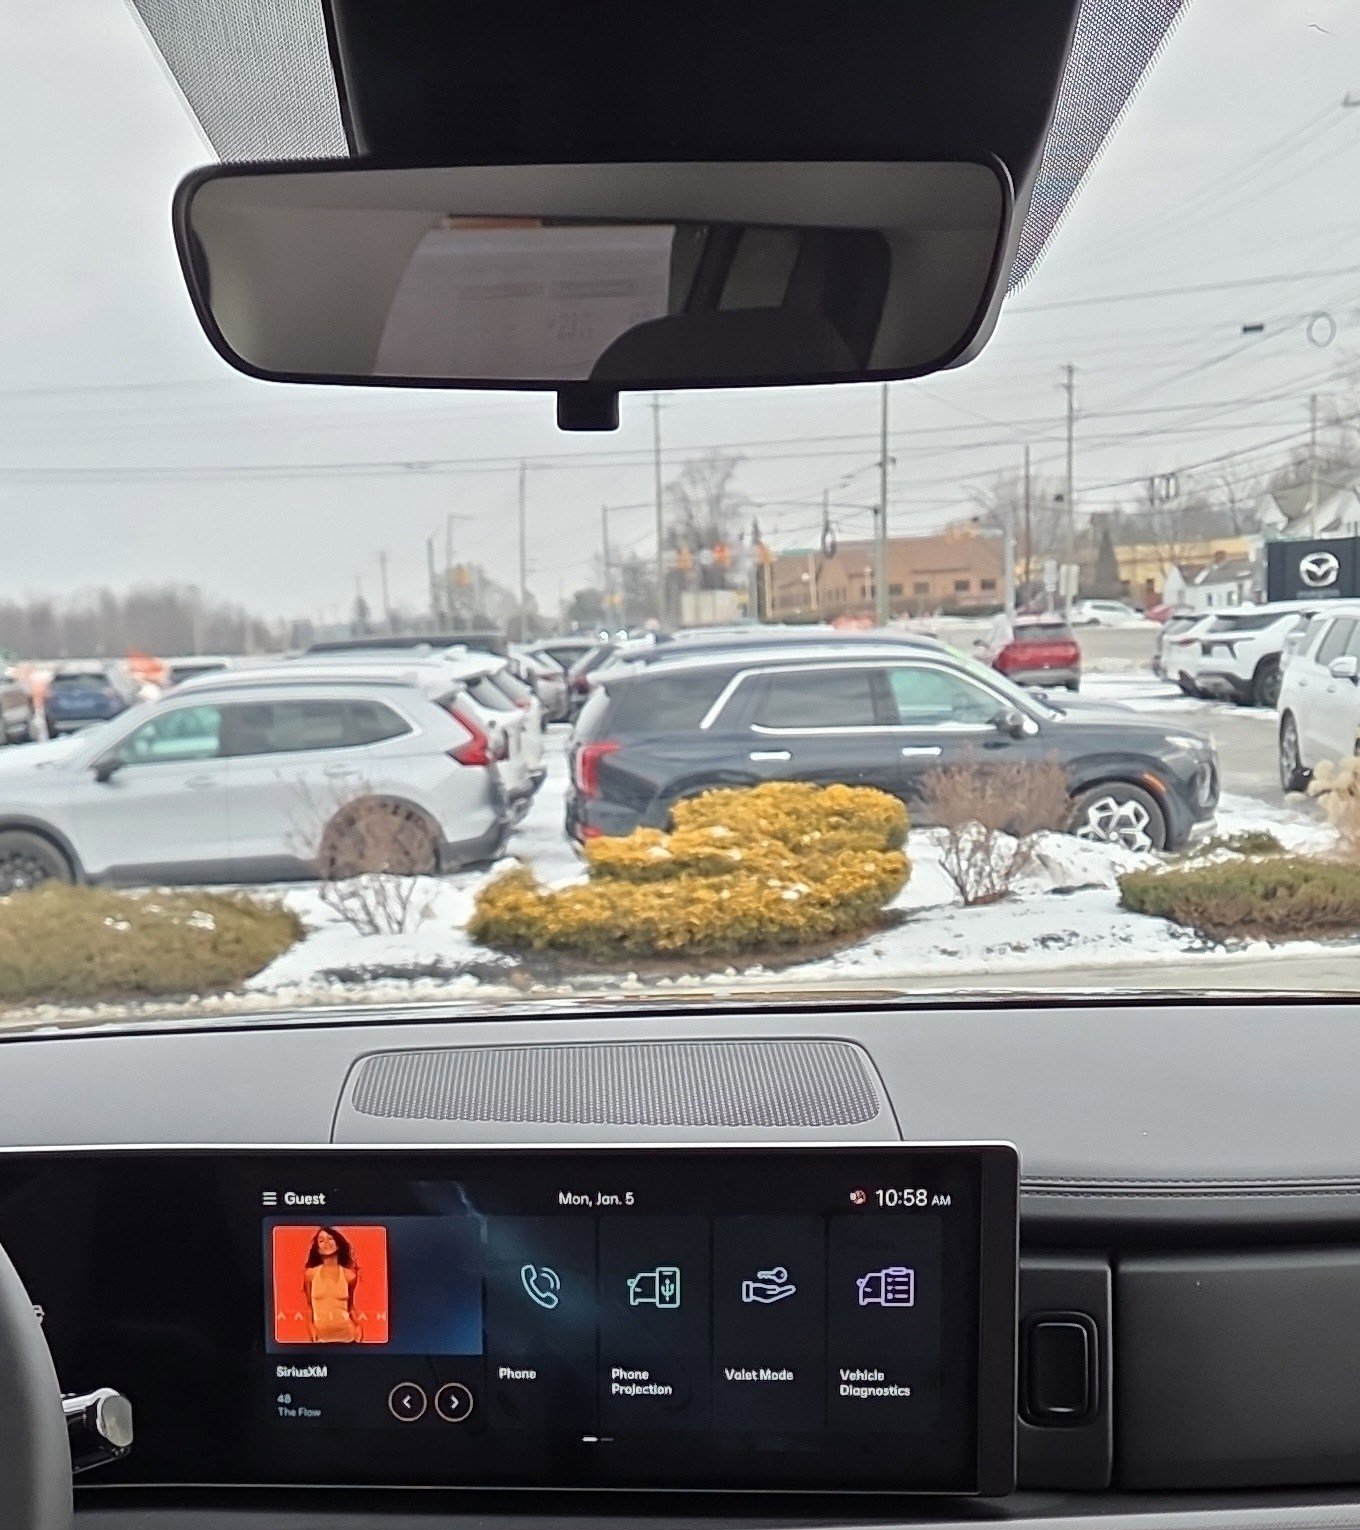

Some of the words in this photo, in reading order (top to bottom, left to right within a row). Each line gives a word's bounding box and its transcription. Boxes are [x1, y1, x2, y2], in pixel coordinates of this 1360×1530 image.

[284, 1191, 326, 1206] Guest
[558, 1191, 593, 1208] Mon,
[595, 1191, 622, 1206] Jan.
[625, 1191, 635, 1206] 5
[875, 1188, 928, 1207] 10:58
[931, 1194, 952, 1206] AM
[276, 1365, 328, 1378] SiriusXM
[498, 1367, 537, 1380] Phone
[611, 1368, 649, 1381] Phone
[724, 1368, 758, 1381] Valet
[759, 1368, 795, 1381] Mode
[839, 1368, 885, 1382] Vehicle
[611, 1383, 673, 1396] Projection
[839, 1384, 911, 1398] Diagnostics
[278, 1407, 296, 1417] The
